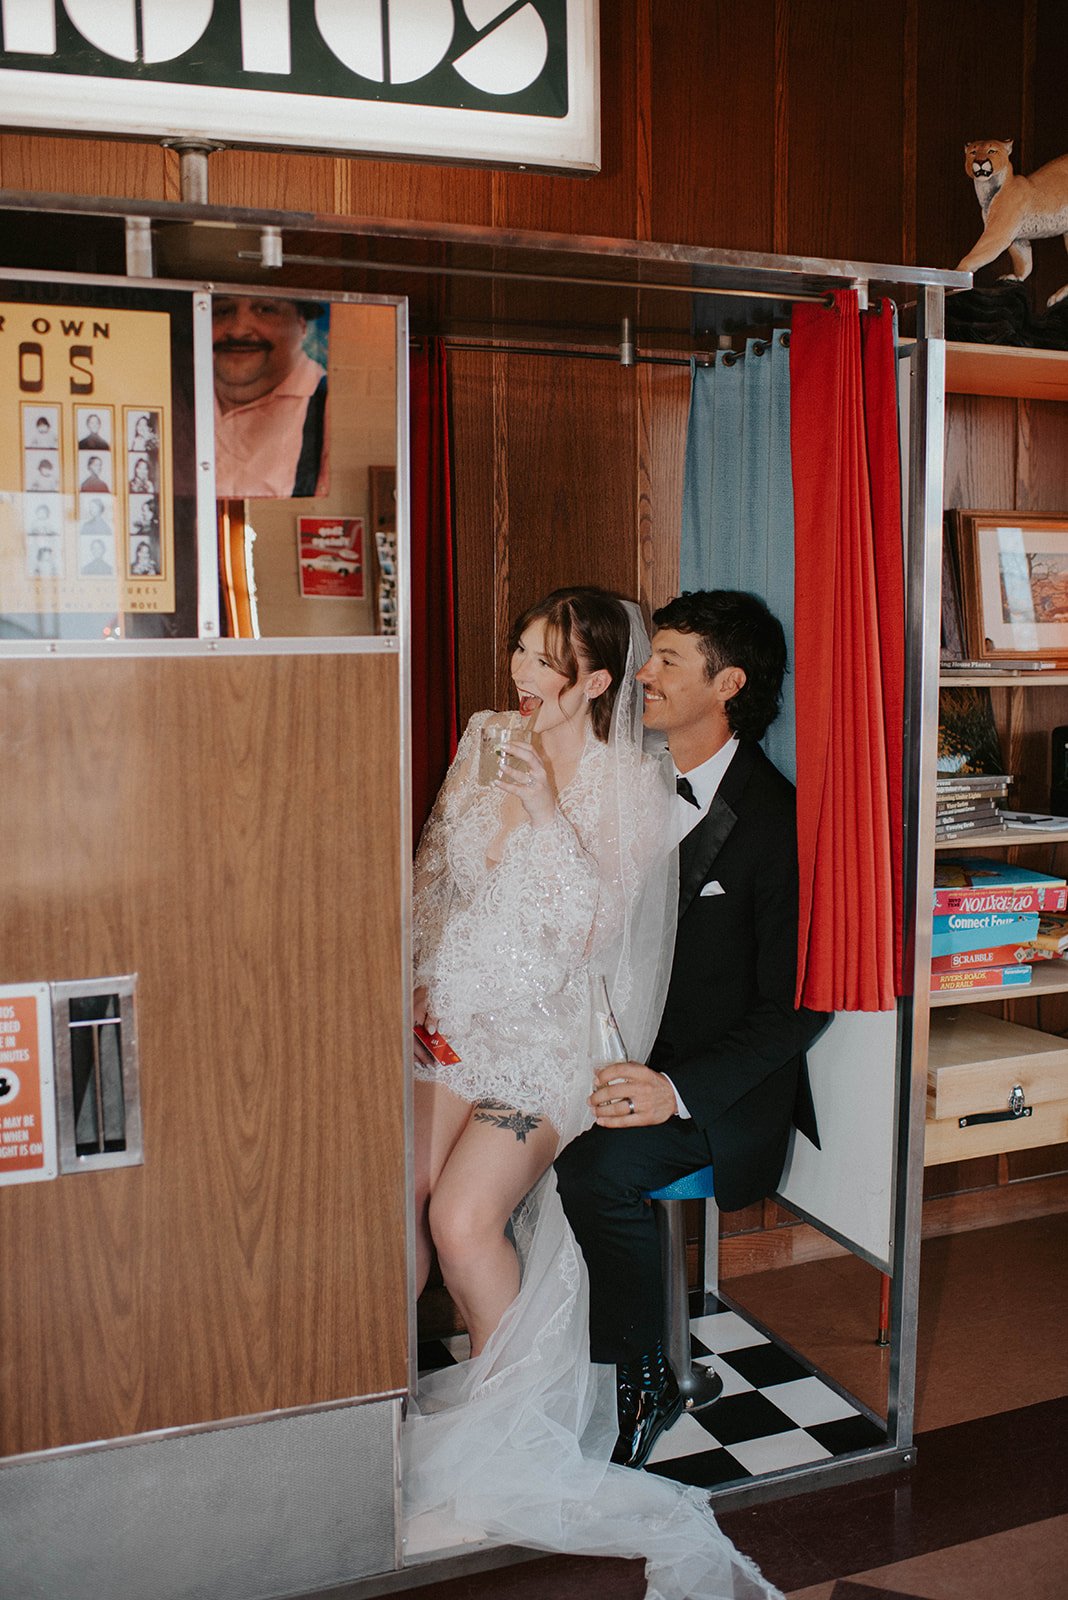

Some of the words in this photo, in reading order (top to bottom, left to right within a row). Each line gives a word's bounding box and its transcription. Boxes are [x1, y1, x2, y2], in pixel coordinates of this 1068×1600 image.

[31, 317, 110, 338] OWN
[19, 341, 94, 395] OS
[971, 660, 992, 669] Plants
[960, 894, 1033, 913] OPERATION
[948, 914, 990, 929] Connect
[952, 952, 994, 966] SCRABBLE
[956, 980, 974, 989] RAILS
[3, 1116, 22, 1129] MAY
[23, 1114, 35, 1128] BE
[3, 1130, 29, 1144] WHEN
[19, 1143, 29, 1157] IS
[29, 1142, 44, 1156] ON
